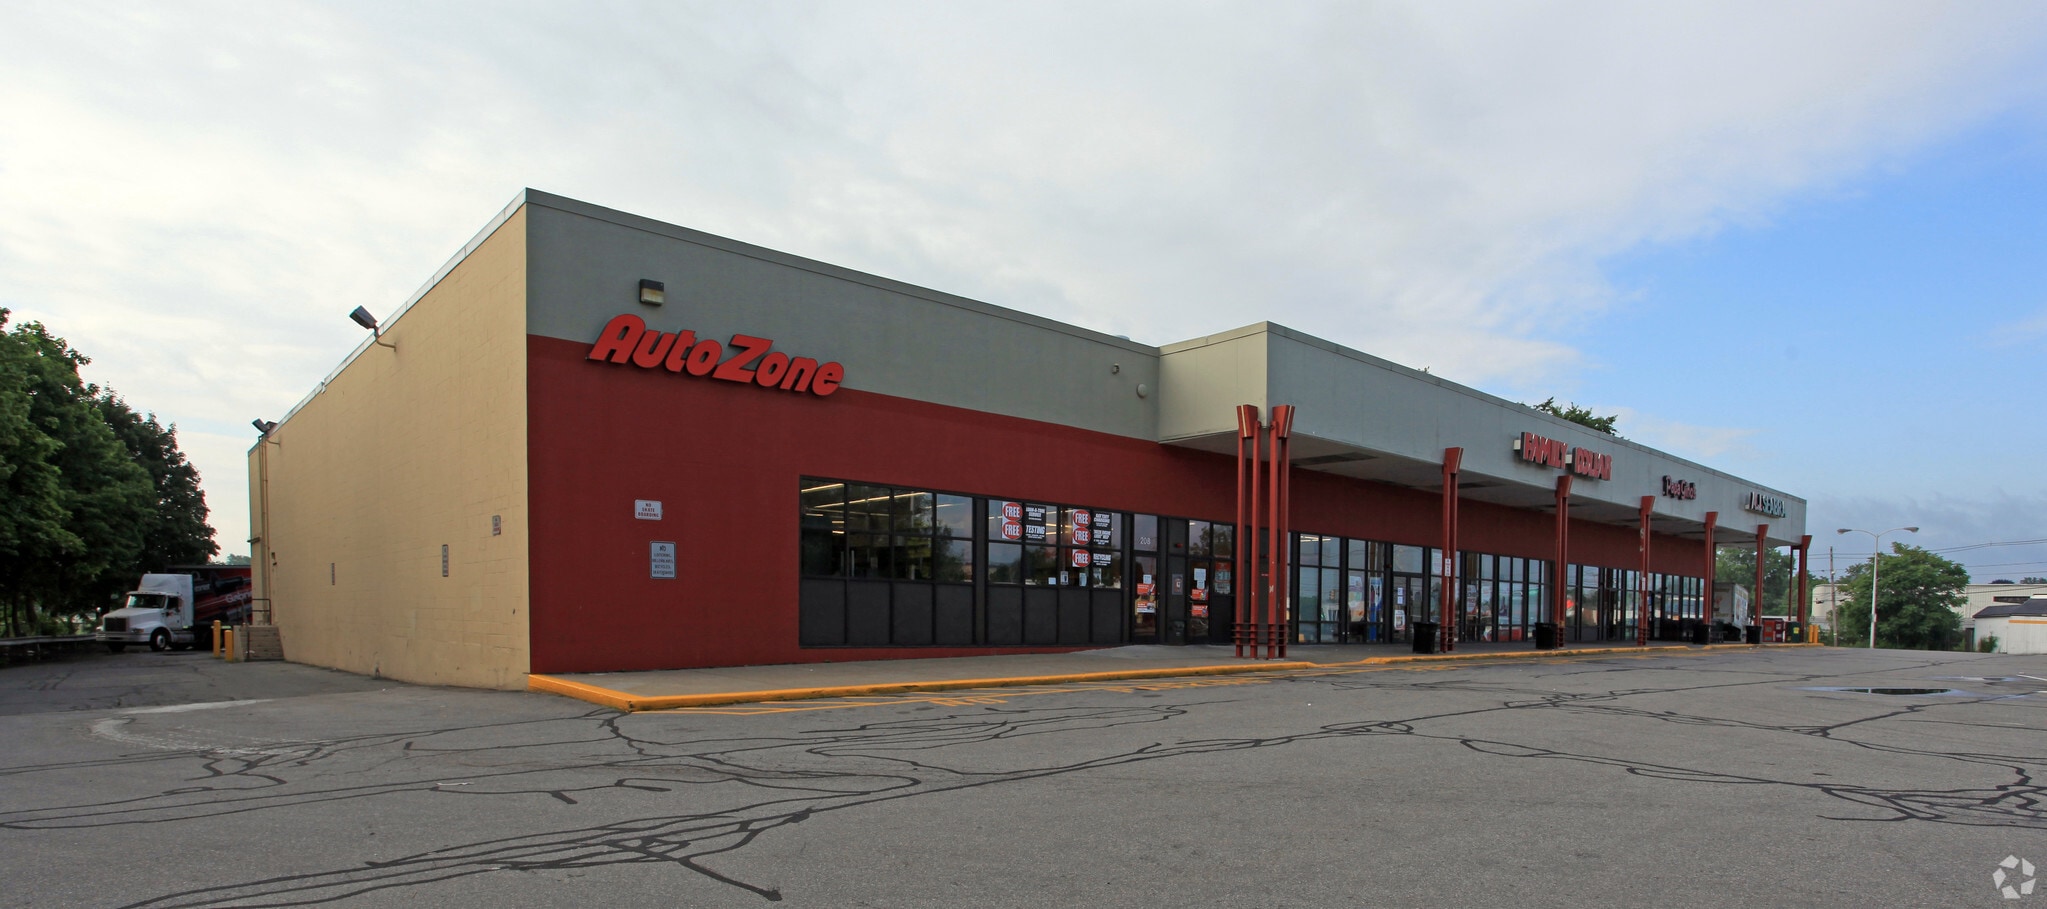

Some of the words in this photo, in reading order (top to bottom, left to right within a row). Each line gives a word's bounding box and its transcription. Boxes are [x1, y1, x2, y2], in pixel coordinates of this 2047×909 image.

[588, 313, 844, 396] AutoZone
[1522, 432, 1568, 469] FAMILY
[1573, 447, 1612, 480] DOLLAR
[1663, 475, 1681, 498] Papa
[1005, 505, 1020, 518] FREE
[1075, 512, 1089, 525] FREE
[1004, 523, 1020, 536] FREE
[1025, 524, 1046, 535] TESTING
[1075, 530, 1089, 542] FREE
[1075, 552, 1089, 564] FREE
